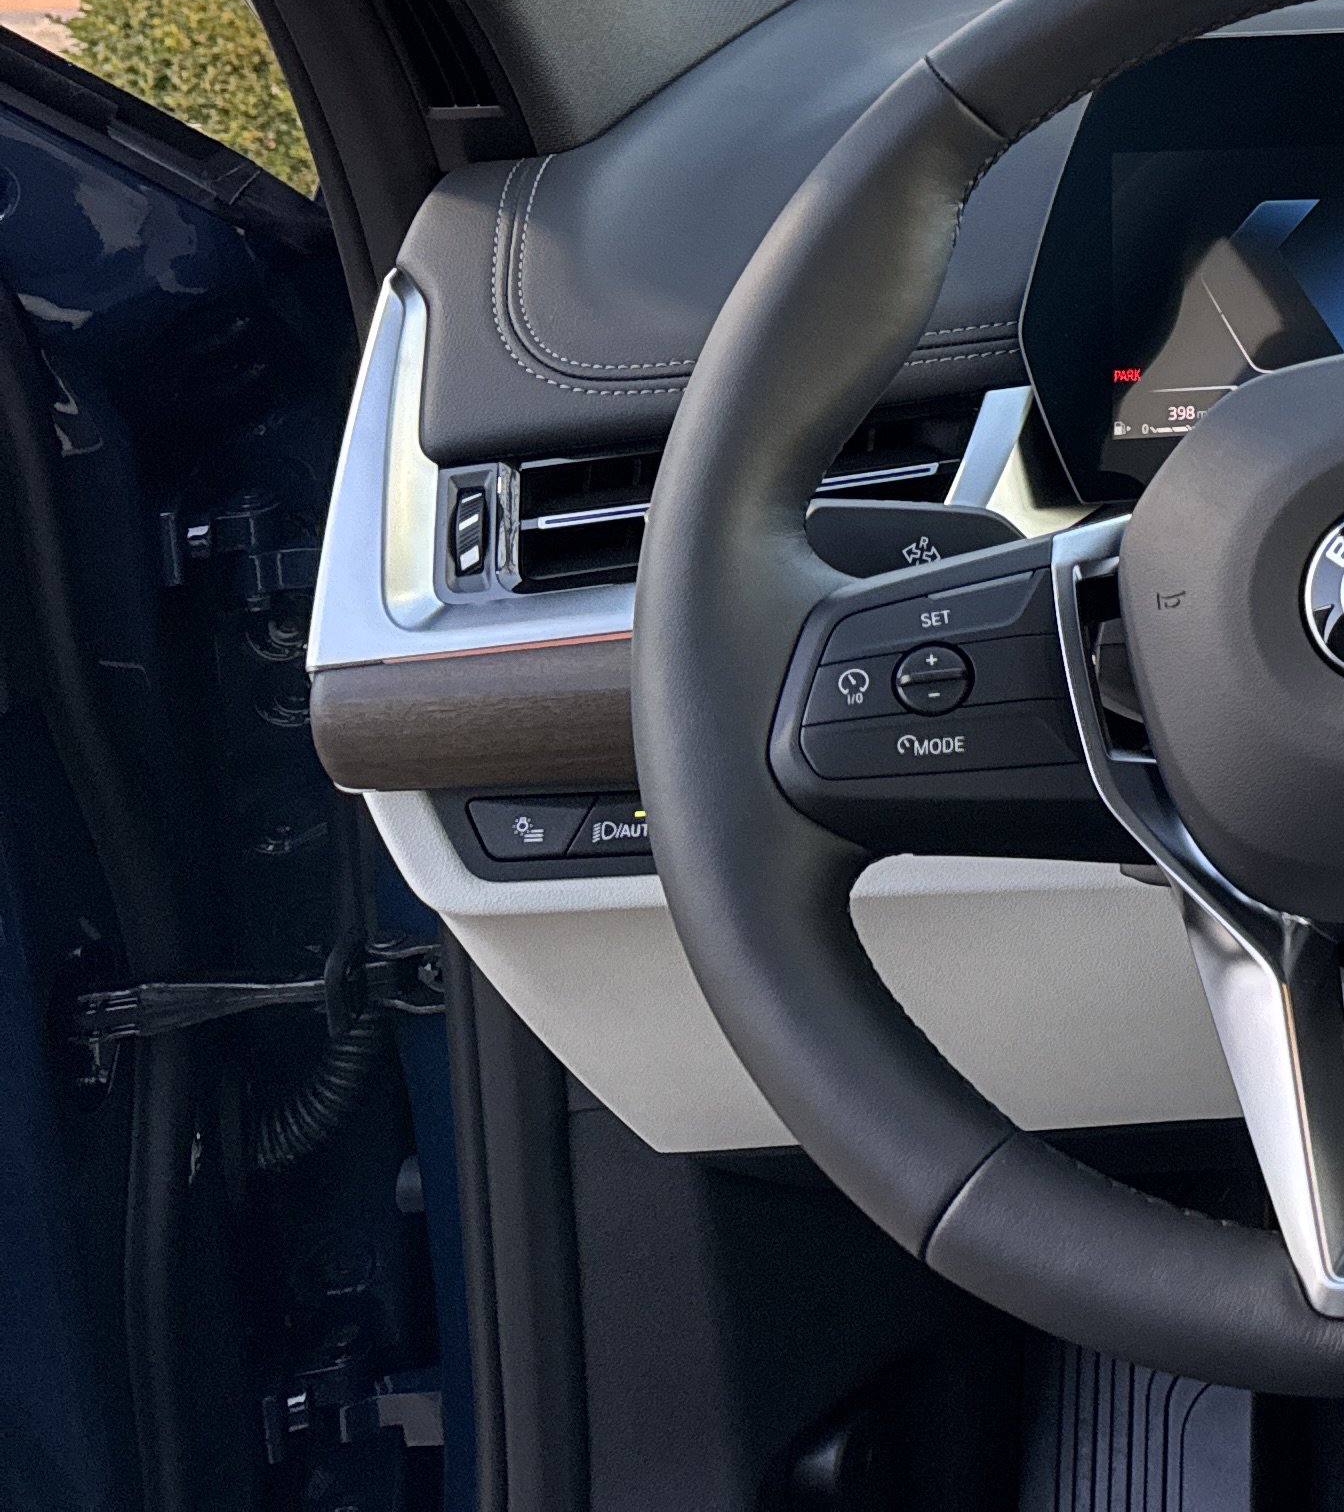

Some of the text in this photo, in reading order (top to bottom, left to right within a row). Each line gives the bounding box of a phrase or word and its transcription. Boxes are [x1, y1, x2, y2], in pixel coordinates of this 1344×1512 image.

[1113, 369, 1141, 383] PARK
[1168, 405, 1195, 421] 398
[920, 610, 951, 628] SET
[914, 735, 965, 756] MODE
